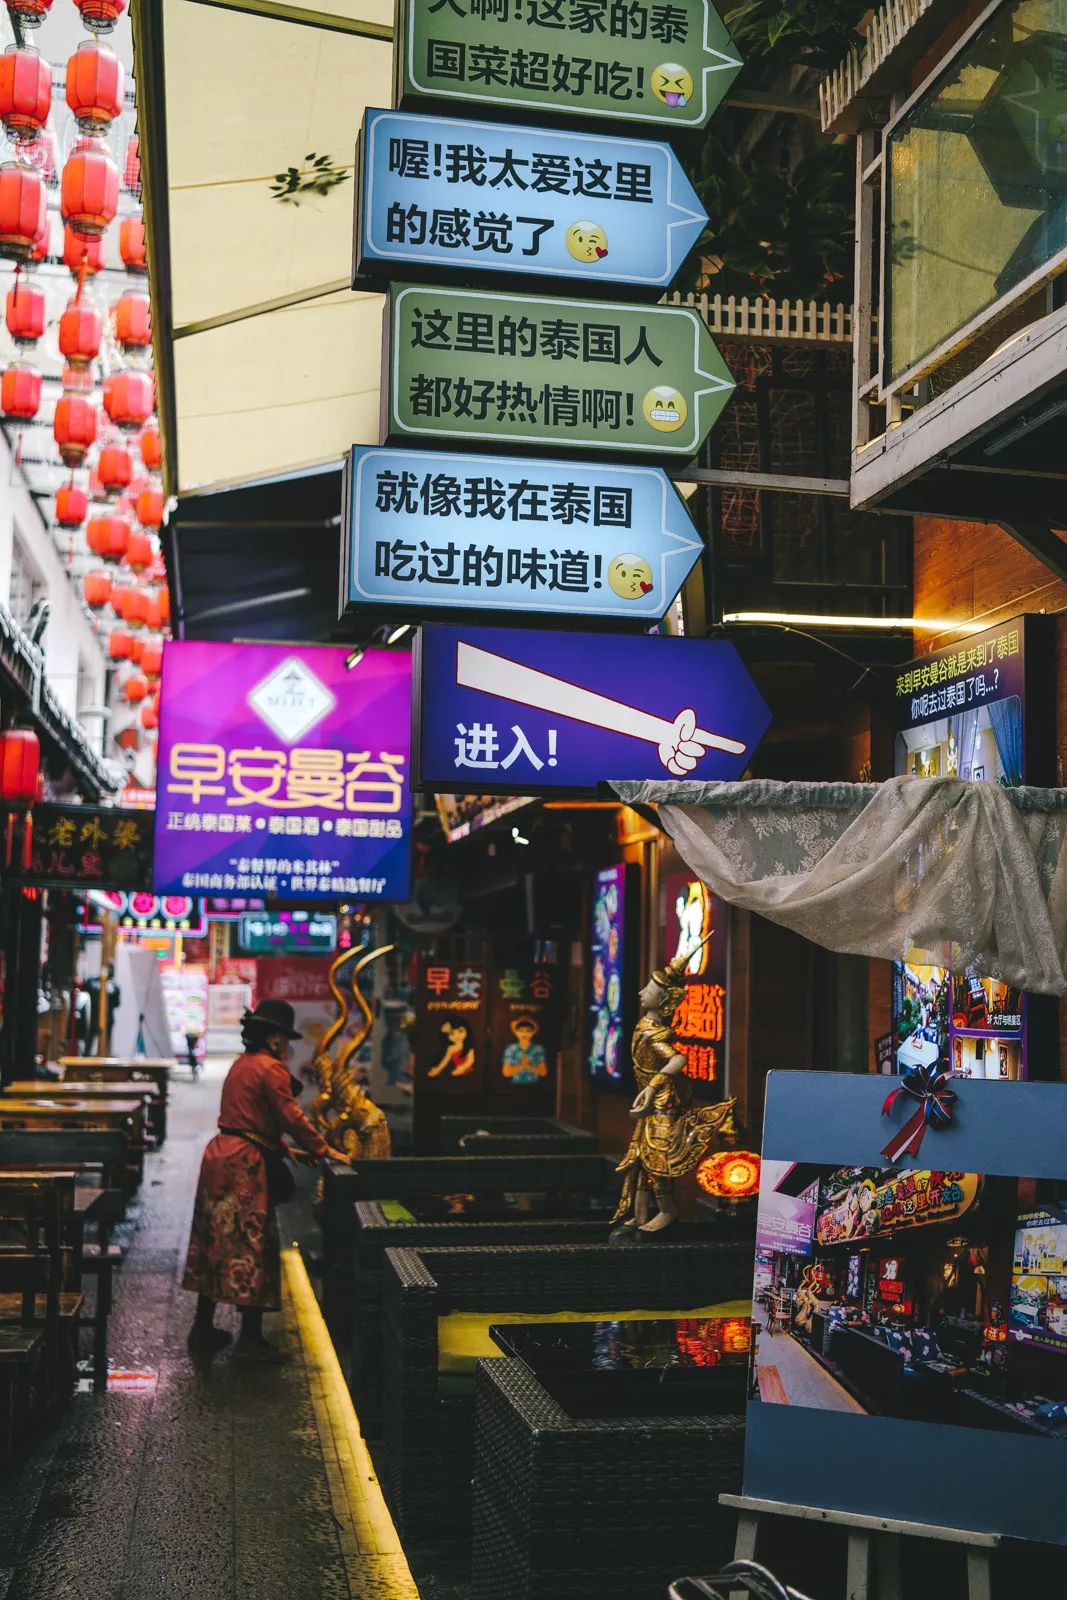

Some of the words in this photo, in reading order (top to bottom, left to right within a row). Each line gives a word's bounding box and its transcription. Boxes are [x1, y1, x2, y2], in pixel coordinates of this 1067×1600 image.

[426, 38, 646, 101] 国菜超好吃!
[387, 136, 654, 204] 喔!我太爱这里
[385, 201, 556, 256] 的感觉了
[409, 306, 664, 368] 这里的泰国人
[408, 372, 635, 430] 都好热情啊!
[374, 469, 633, 529] 就像我在泰国
[374, 538, 604, 593] 吃过的味道!
[895, 629, 1020, 697] 来到早安曼谷就是来到了泰国
[166, 742, 406, 813] 早安曼谷
[453, 722, 559, 772] 进入!
